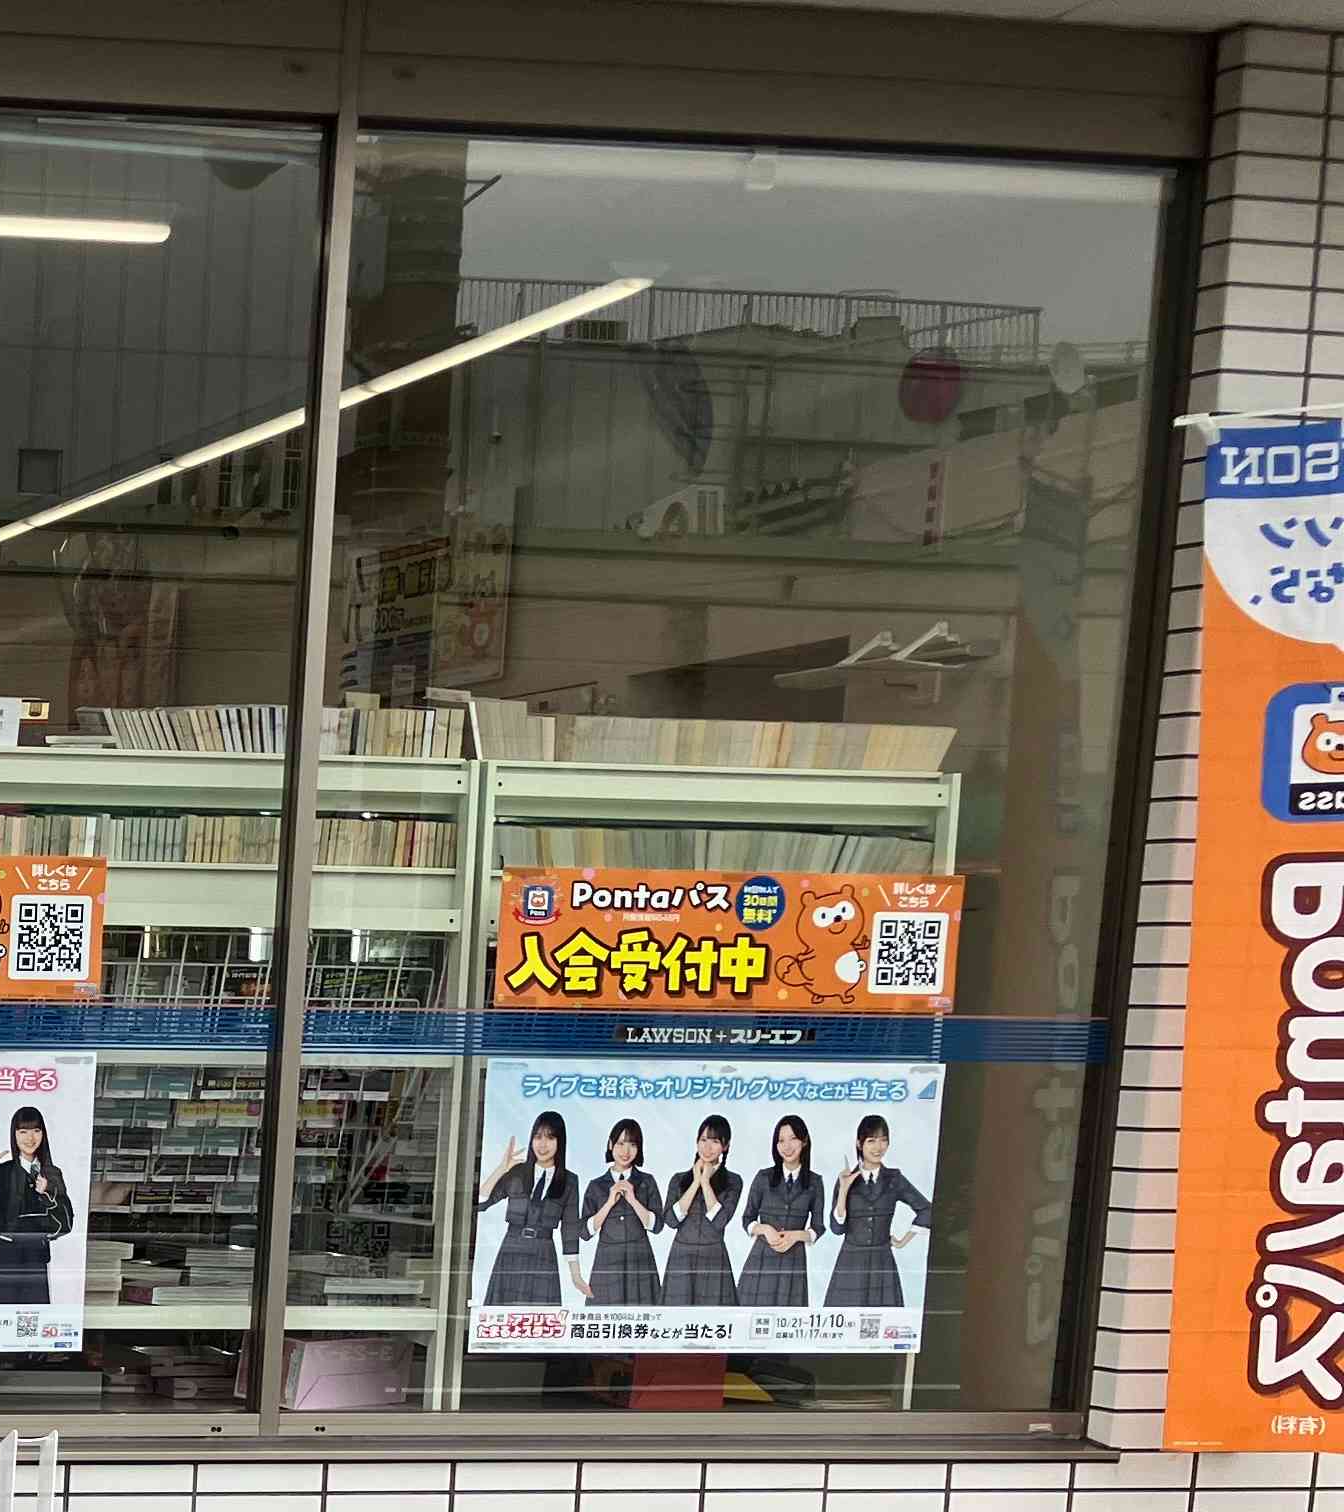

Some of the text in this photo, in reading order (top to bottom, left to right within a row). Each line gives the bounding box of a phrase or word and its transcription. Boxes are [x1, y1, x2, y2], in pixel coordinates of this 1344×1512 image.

[31, 863, 78, 879] 詳しくは
[36, 879, 71, 891] こちら
[892, 882, 937, 897] 詳しくは
[570, 880, 731, 911] Pontaパス
[743, 894, 779, 907] 30日間
[896, 896, 930, 908] こちら
[507, 928, 768, 994] 入会受付中
[625, 1027, 804, 1045] LAWSON スリーエフ
[570, 1323, 733, 1340] 商品引換券などが当たる!
